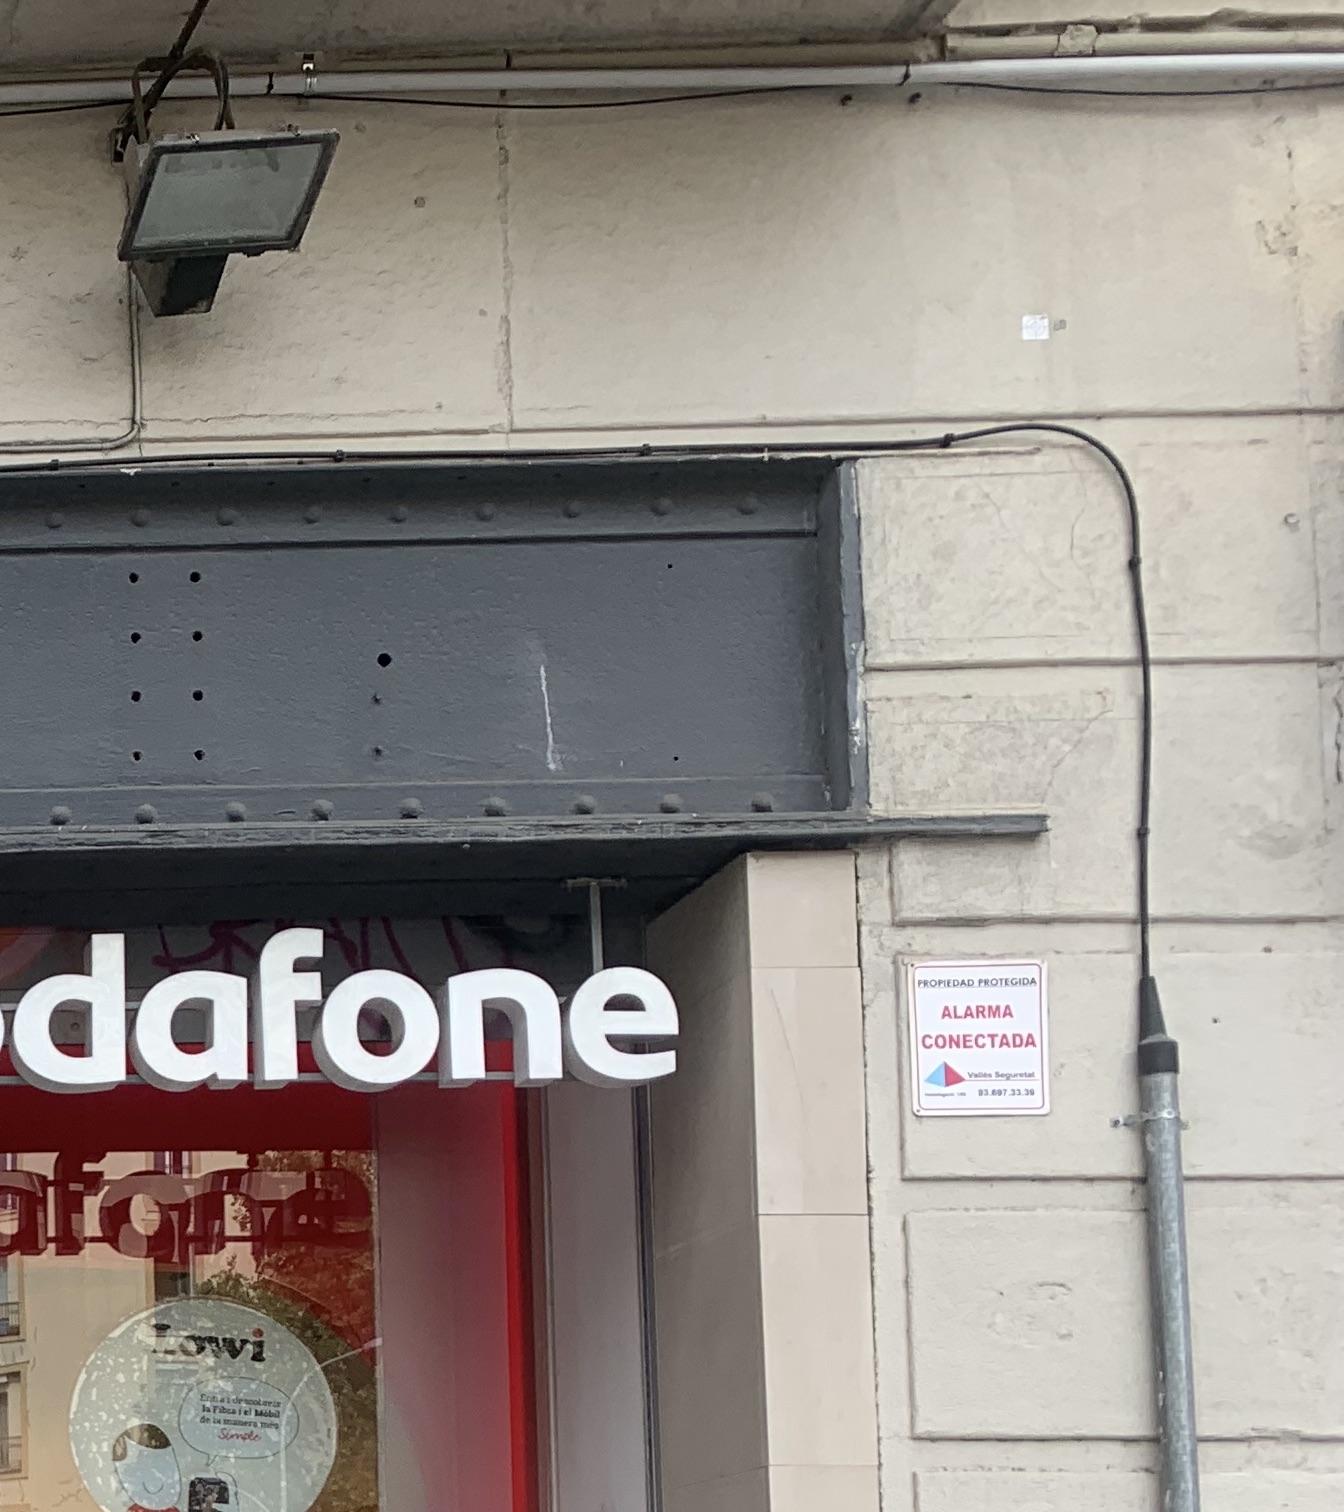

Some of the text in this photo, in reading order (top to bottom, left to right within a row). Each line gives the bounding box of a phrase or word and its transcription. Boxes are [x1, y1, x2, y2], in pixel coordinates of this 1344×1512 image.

[917, 977, 1037, 988] PROPIEDAD PROTEGIDA
[941, 1004, 1014, 1019] ALARMA
[921, 1033, 1037, 1049] CONECTADA
[152, 1323, 266, 1362] Lowi
[202, 1405, 211, 1413] la
[213, 1406, 237, 1415] Fibra
